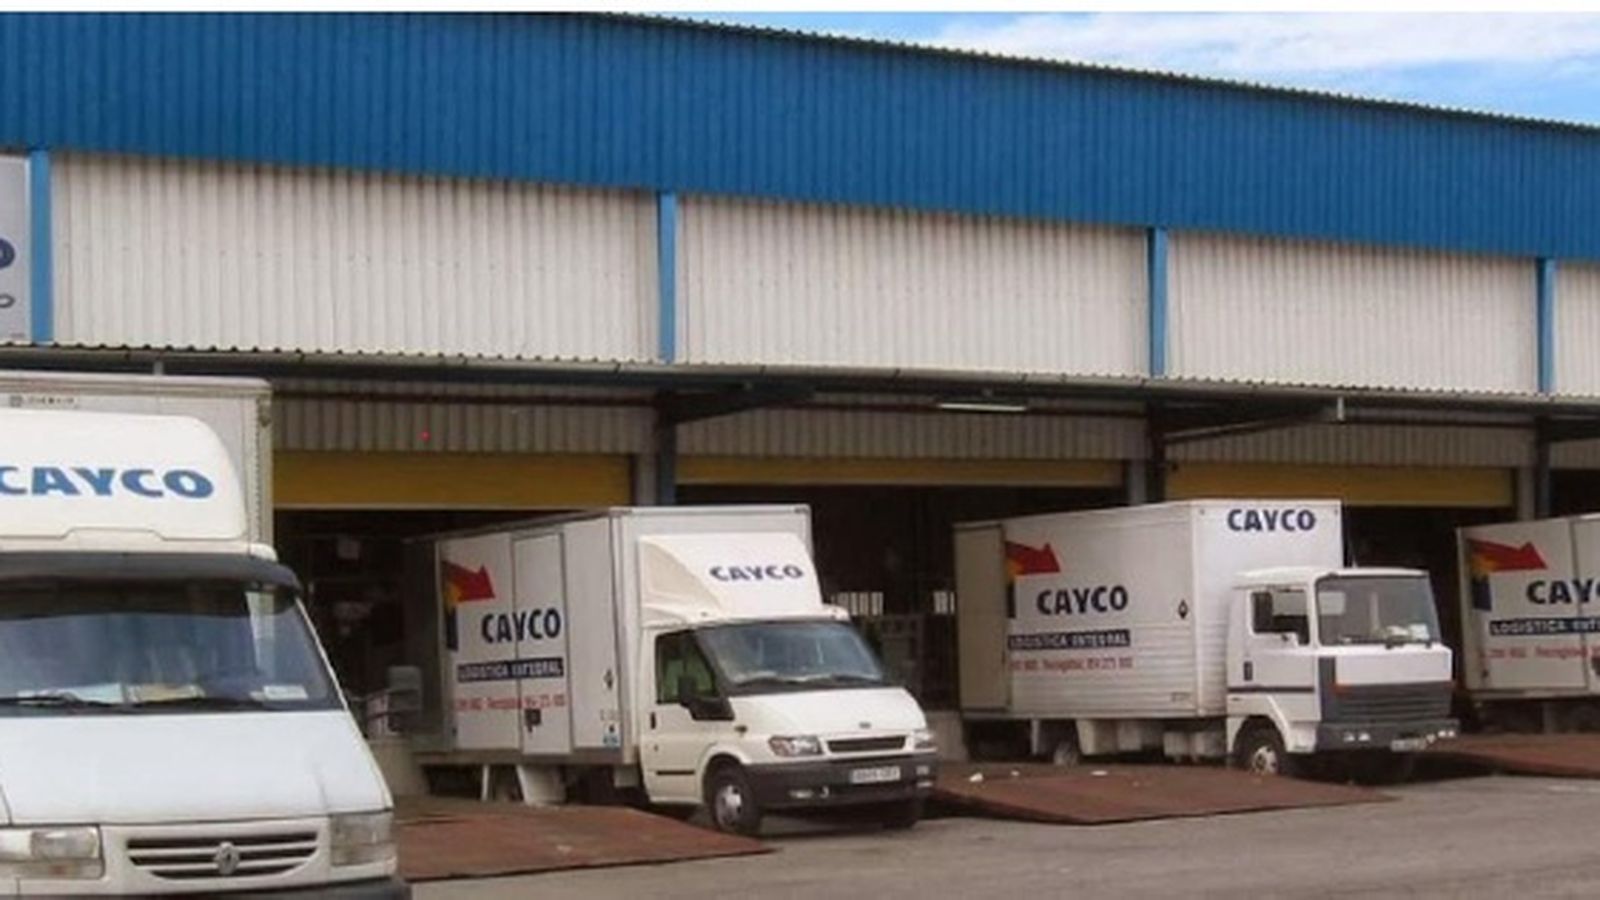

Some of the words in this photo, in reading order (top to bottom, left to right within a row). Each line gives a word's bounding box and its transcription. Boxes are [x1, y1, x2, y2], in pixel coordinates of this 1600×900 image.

[0, 466, 214, 500] CAYCO
[1227, 508, 1316, 532] CAYCO
[710, 564, 805, 583] CAYCO
[1037, 585, 1129, 615] CAYCO
[1527, 578, 1600, 604] CAY
[481, 607, 562, 644] CAYCO
[1492, 619, 1567, 635] LOGISTICA
